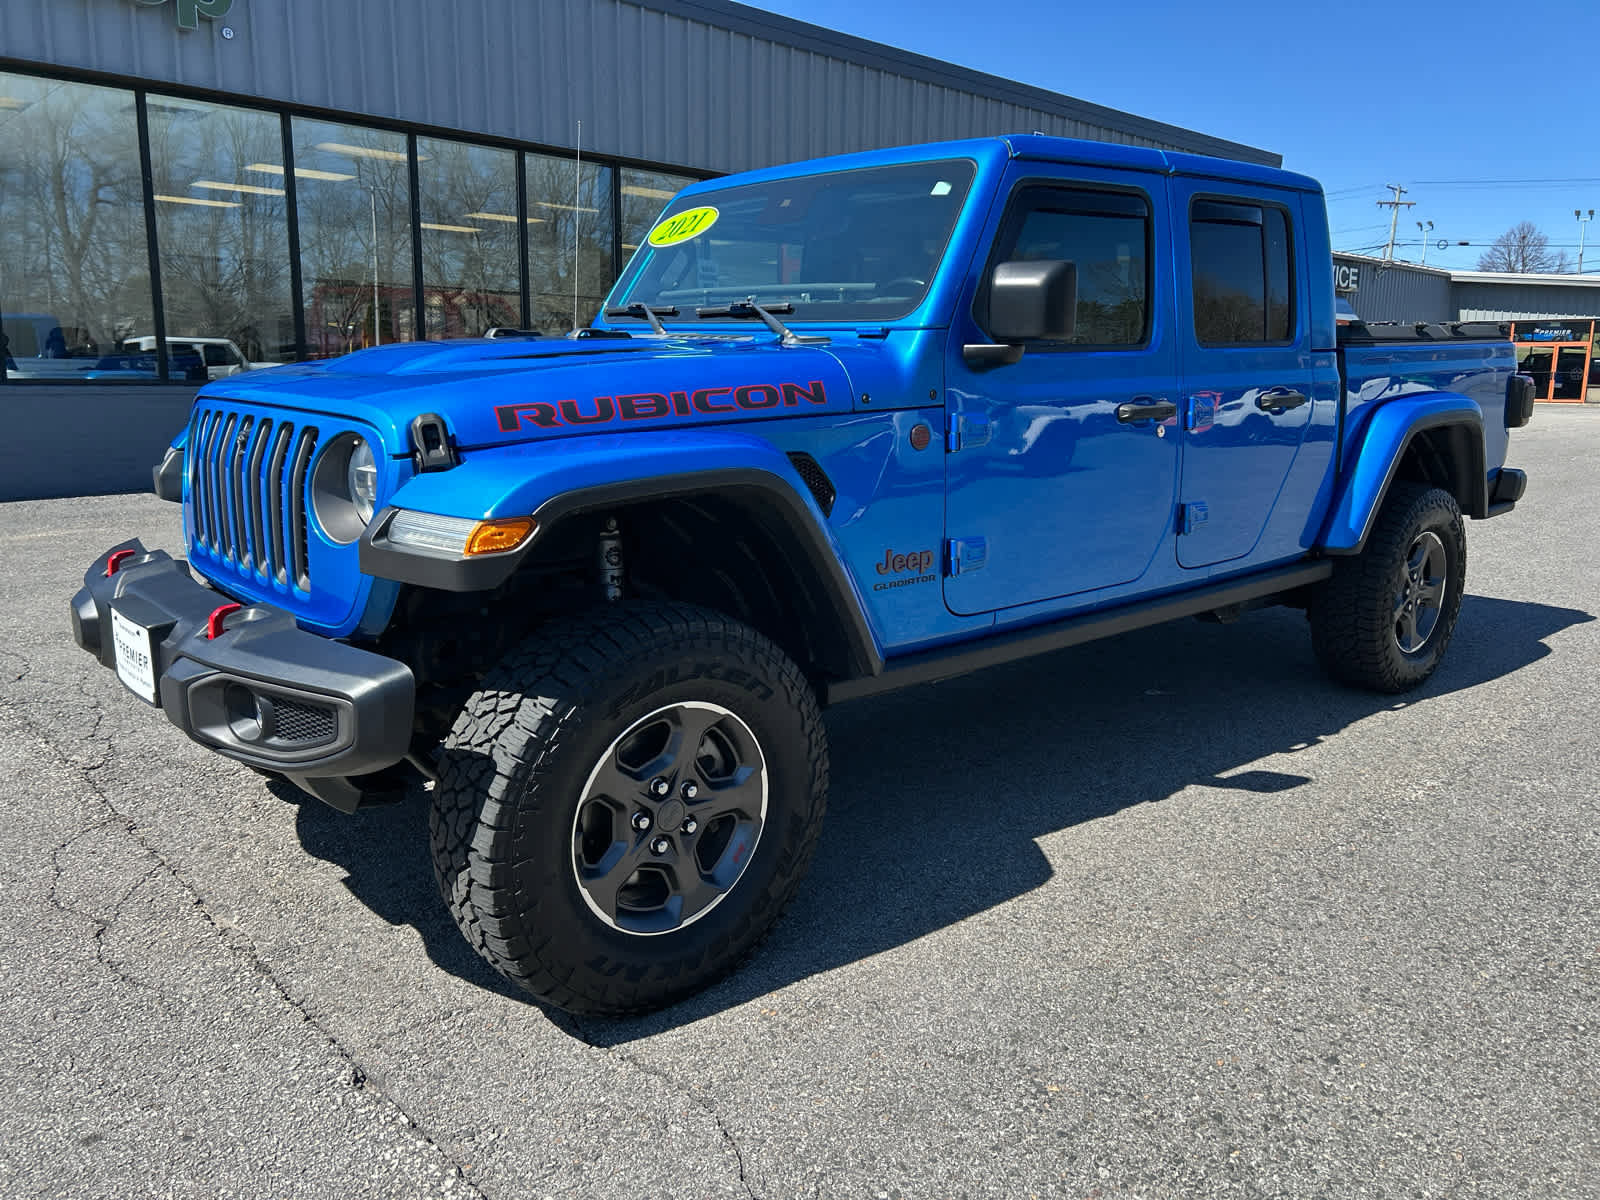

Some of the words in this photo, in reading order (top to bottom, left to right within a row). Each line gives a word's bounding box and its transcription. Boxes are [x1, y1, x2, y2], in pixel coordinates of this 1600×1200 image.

[656, 210, 710, 242] 2021
[1333, 264, 1359, 288] ICE
[494, 380, 828, 433] RUBICON
[876, 549, 933, 575] Jeep
[873, 574, 936, 591] GLADIATOR
[119, 638, 149, 669] PREMIER
